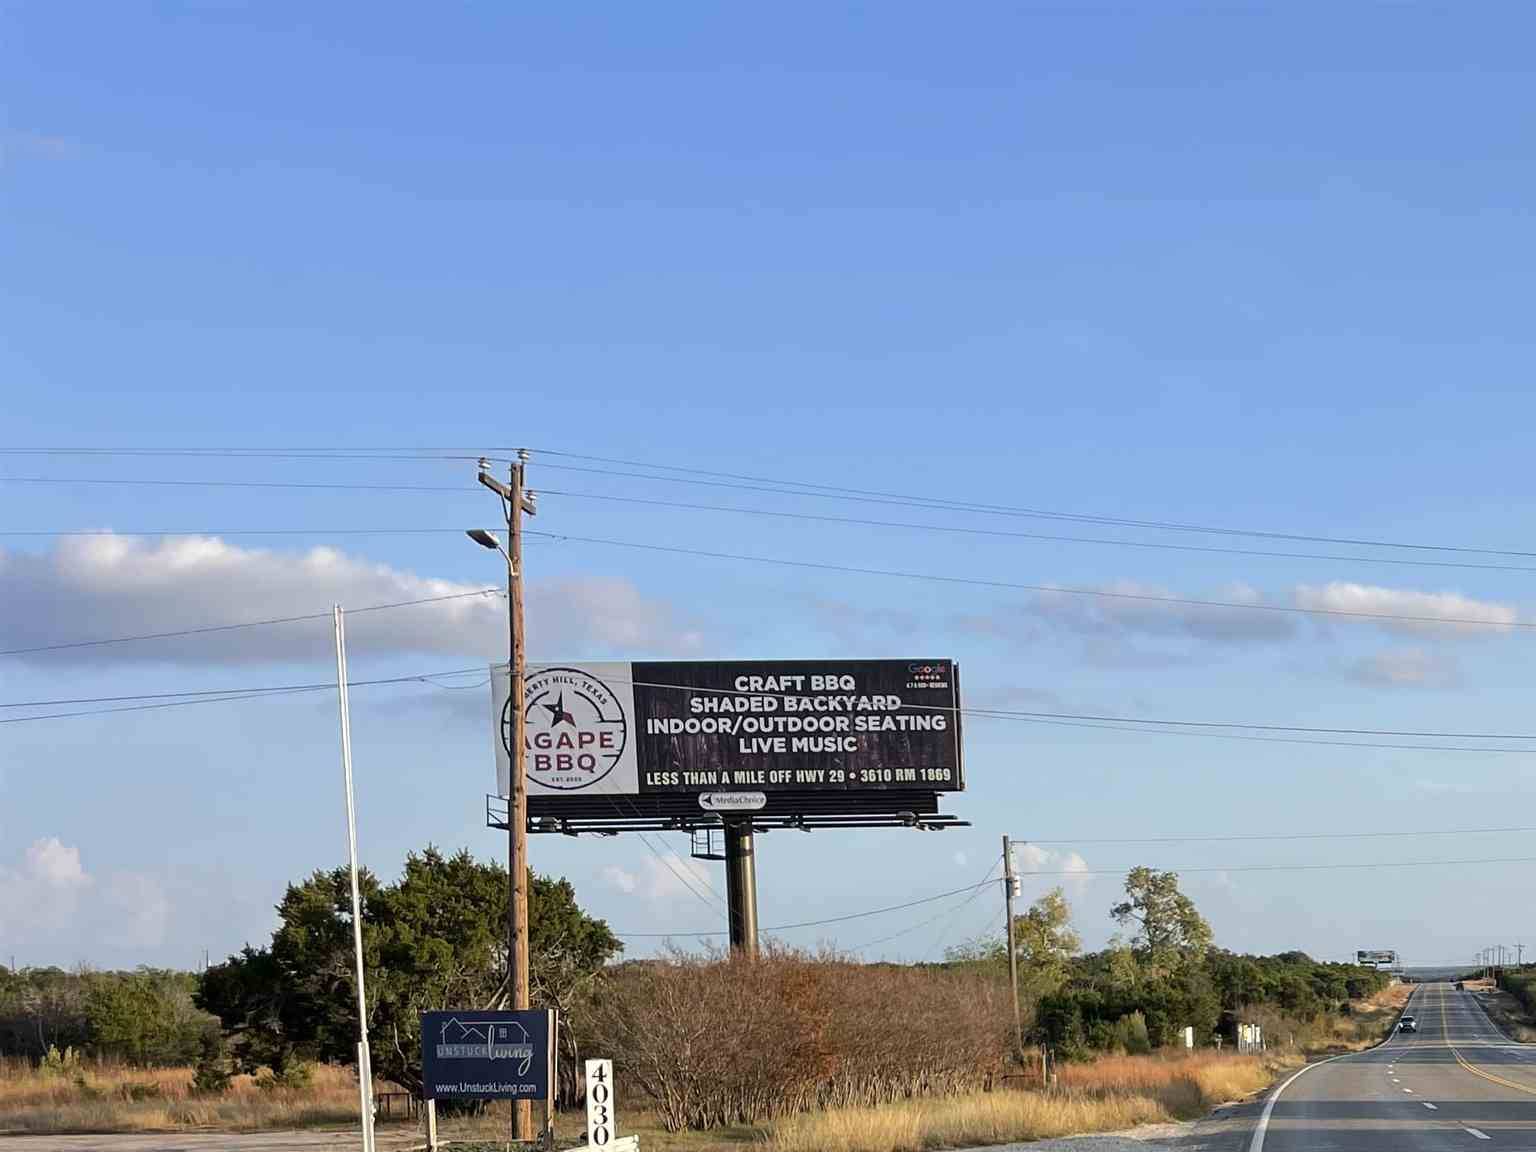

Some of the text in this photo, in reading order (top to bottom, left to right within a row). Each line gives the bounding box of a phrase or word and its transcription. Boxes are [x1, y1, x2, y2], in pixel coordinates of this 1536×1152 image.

[735, 675, 856, 691] CRAFT BBQ
[582, 681, 608, 705] TEXAS
[690, 695, 902, 713] SHADED BACKYARD
[647, 715, 947, 735] INDOOR/OUTDOOR SEATING
[739, 736, 858, 753] LIVE MUSIC
[534, 753, 597, 774] BBQ
[646, 768, 951, 786] LESS THAN A MILE OFF HWY 29 3610 RM 1869
[435, 1082, 537, 1095] www.UnstuckLiving.com
[592, 1064, 609, 1146] 4030
